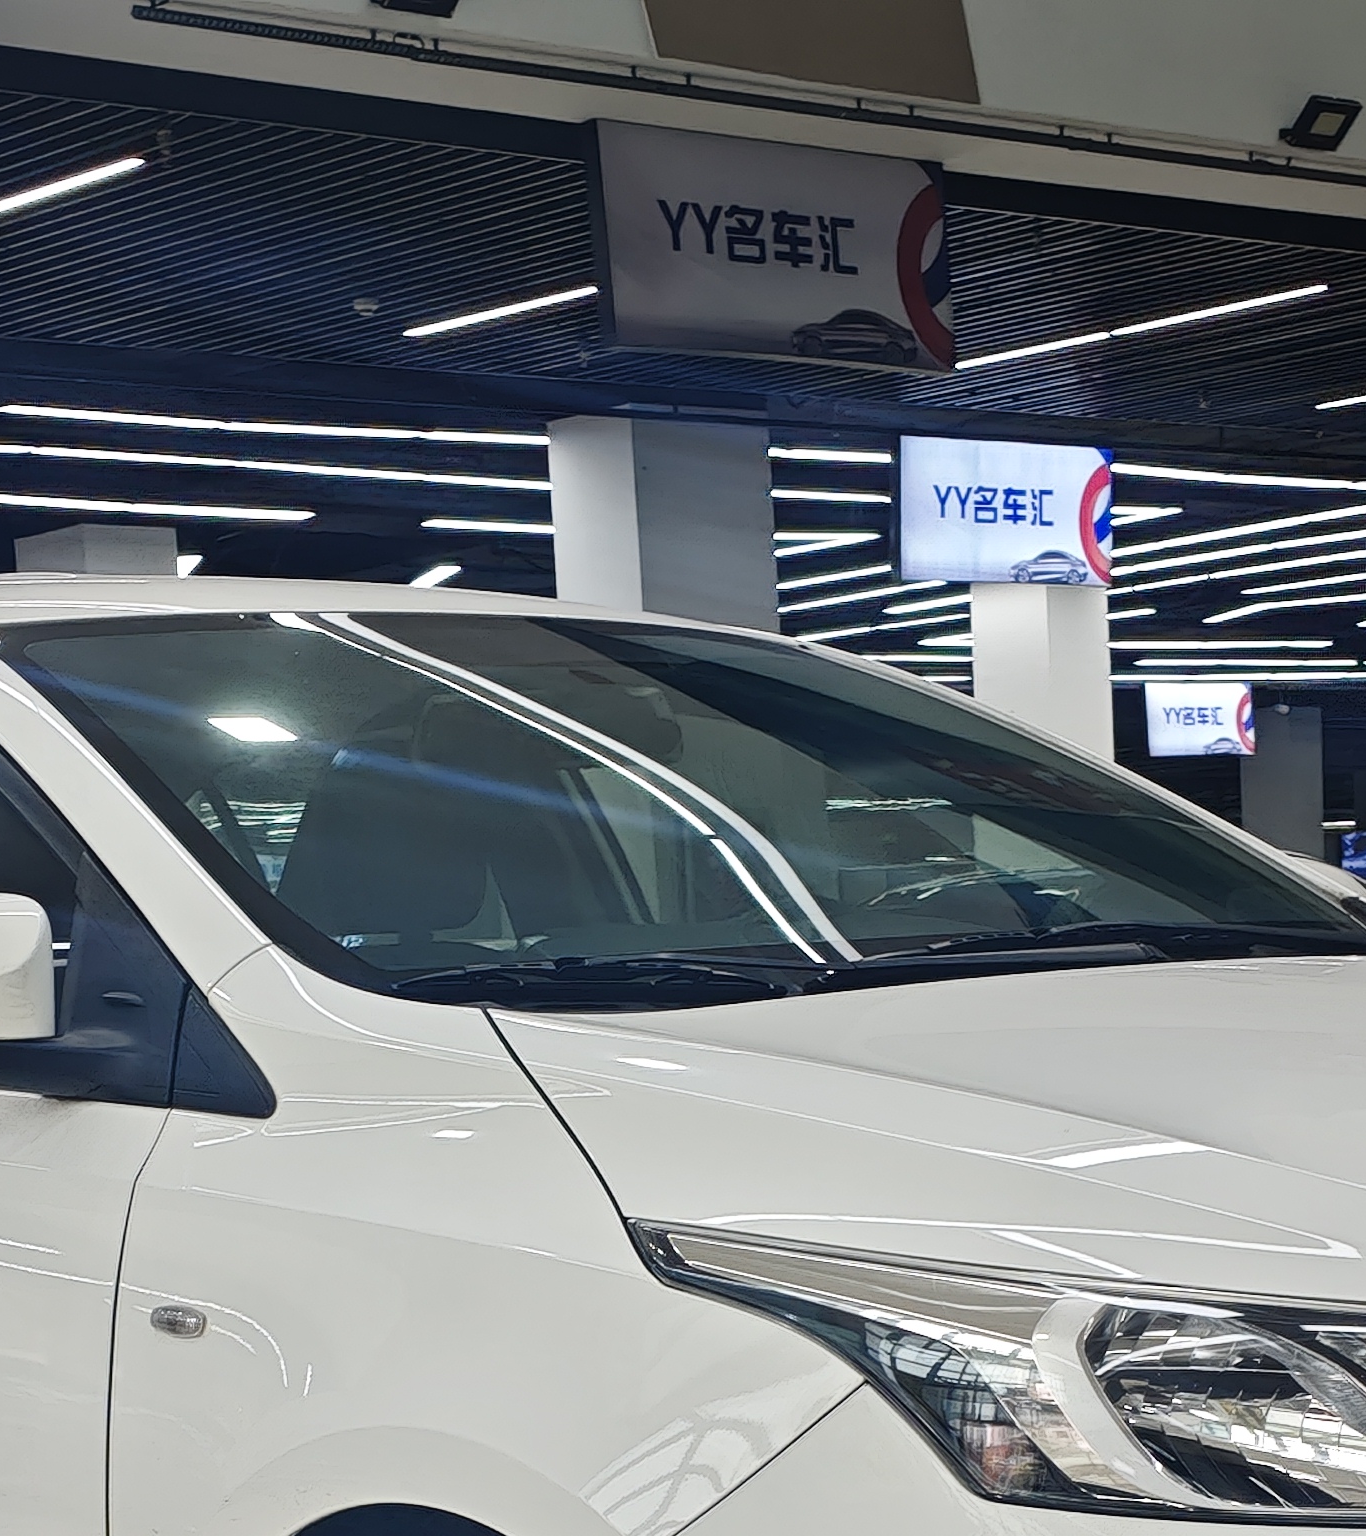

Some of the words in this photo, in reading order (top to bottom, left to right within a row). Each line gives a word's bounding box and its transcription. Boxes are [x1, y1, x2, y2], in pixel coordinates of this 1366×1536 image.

[656, 199, 859, 276] YY名车汇
[932, 484, 1055, 526] YY名车汇
[1162, 706, 1224, 726] YY名车汇
